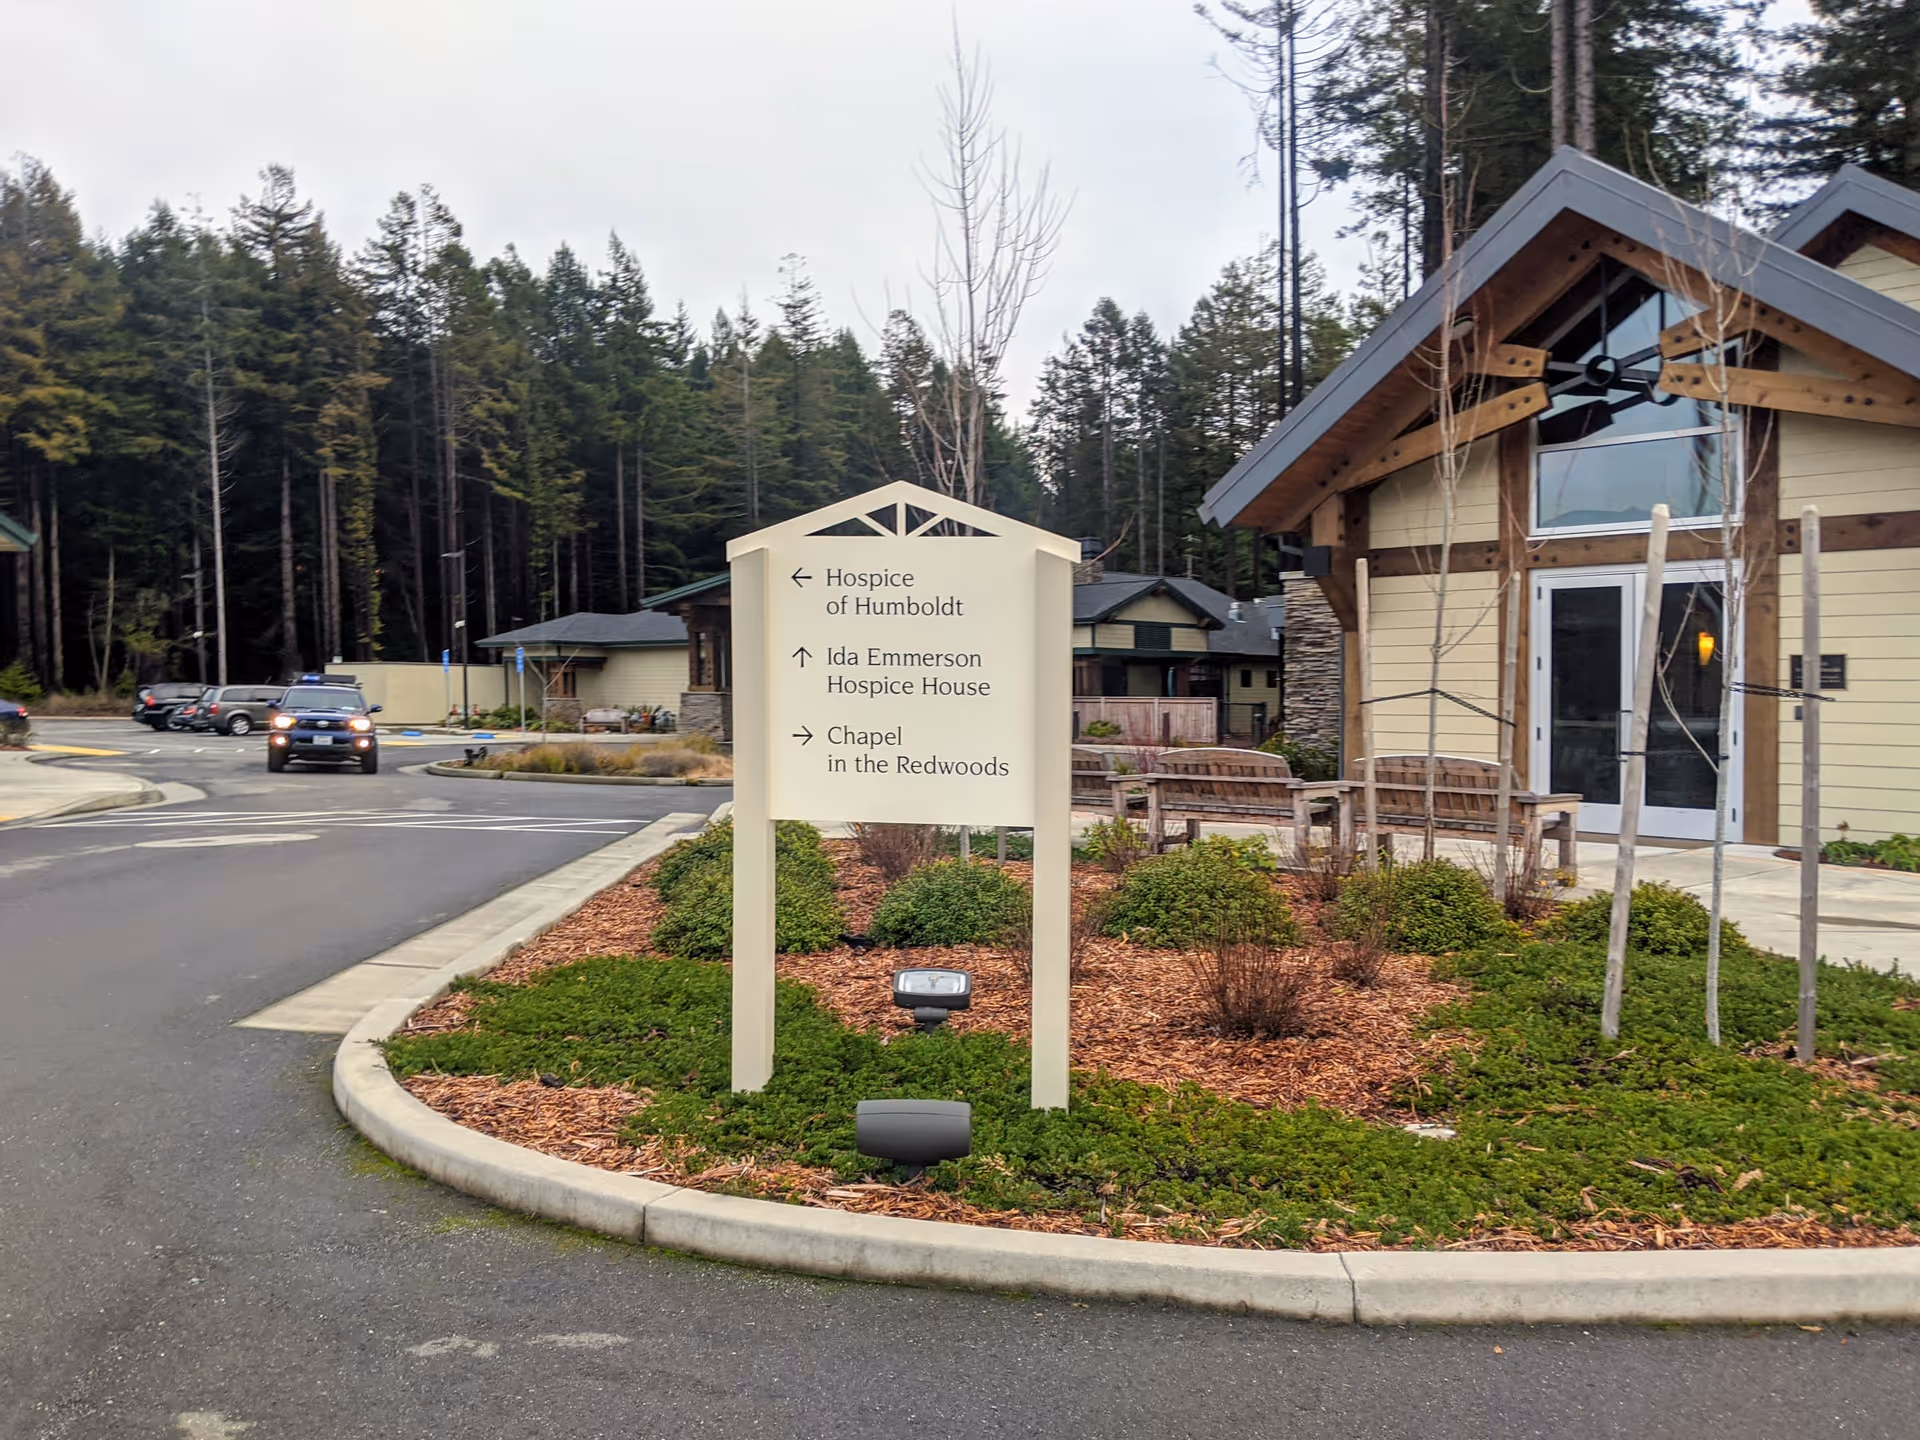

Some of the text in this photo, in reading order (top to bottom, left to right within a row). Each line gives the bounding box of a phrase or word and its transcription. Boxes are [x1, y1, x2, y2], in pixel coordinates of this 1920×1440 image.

[827, 567, 915, 591] Hospice
[826, 594, 965, 617] of Humboldt
[827, 645, 983, 668] Ida Emmerson
[827, 675, 992, 698] Hospice House
[827, 725, 903, 749] Chapel
[827, 754, 1010, 777] in the Redwoods
